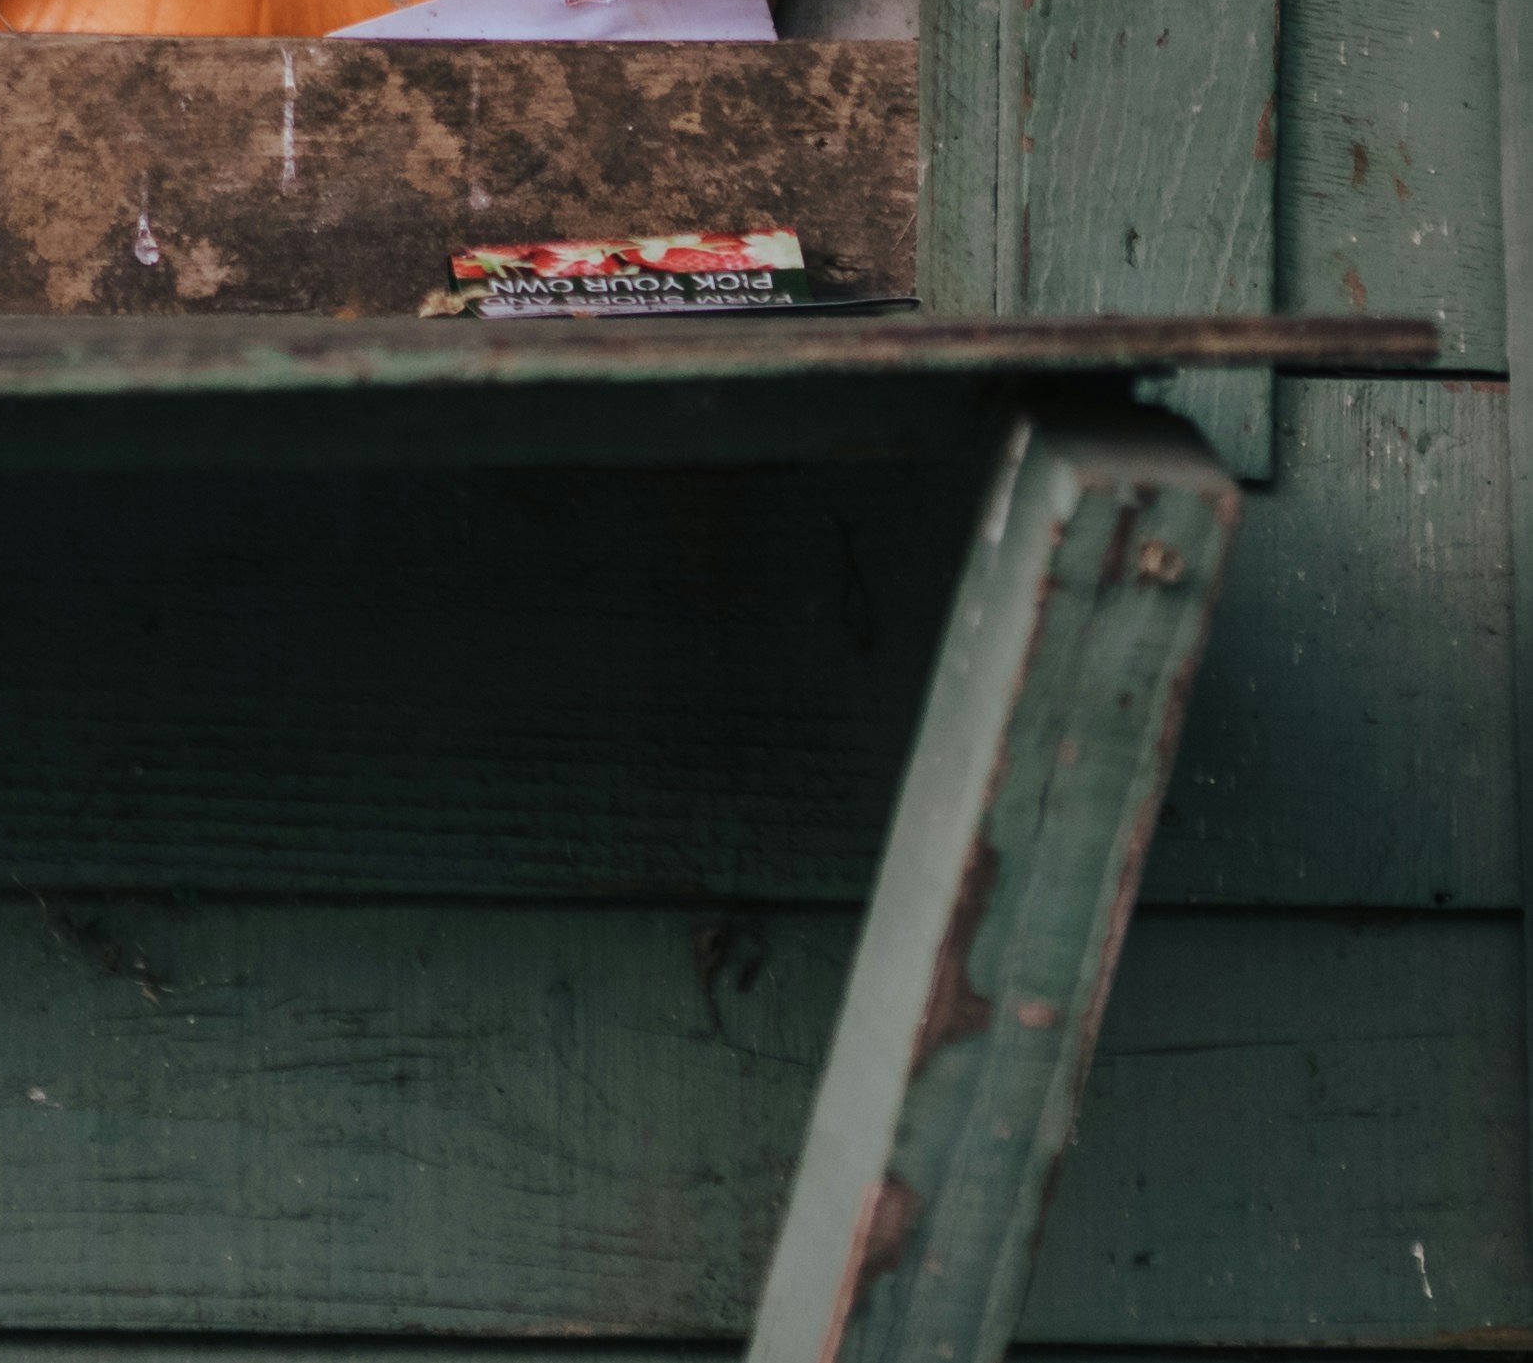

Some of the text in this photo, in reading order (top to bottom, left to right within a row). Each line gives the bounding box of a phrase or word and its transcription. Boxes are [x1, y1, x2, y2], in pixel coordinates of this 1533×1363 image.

[489, 272, 775, 295] PICK YOUR OWN
[482, 293, 794, 308] FARM SHOPS AND
